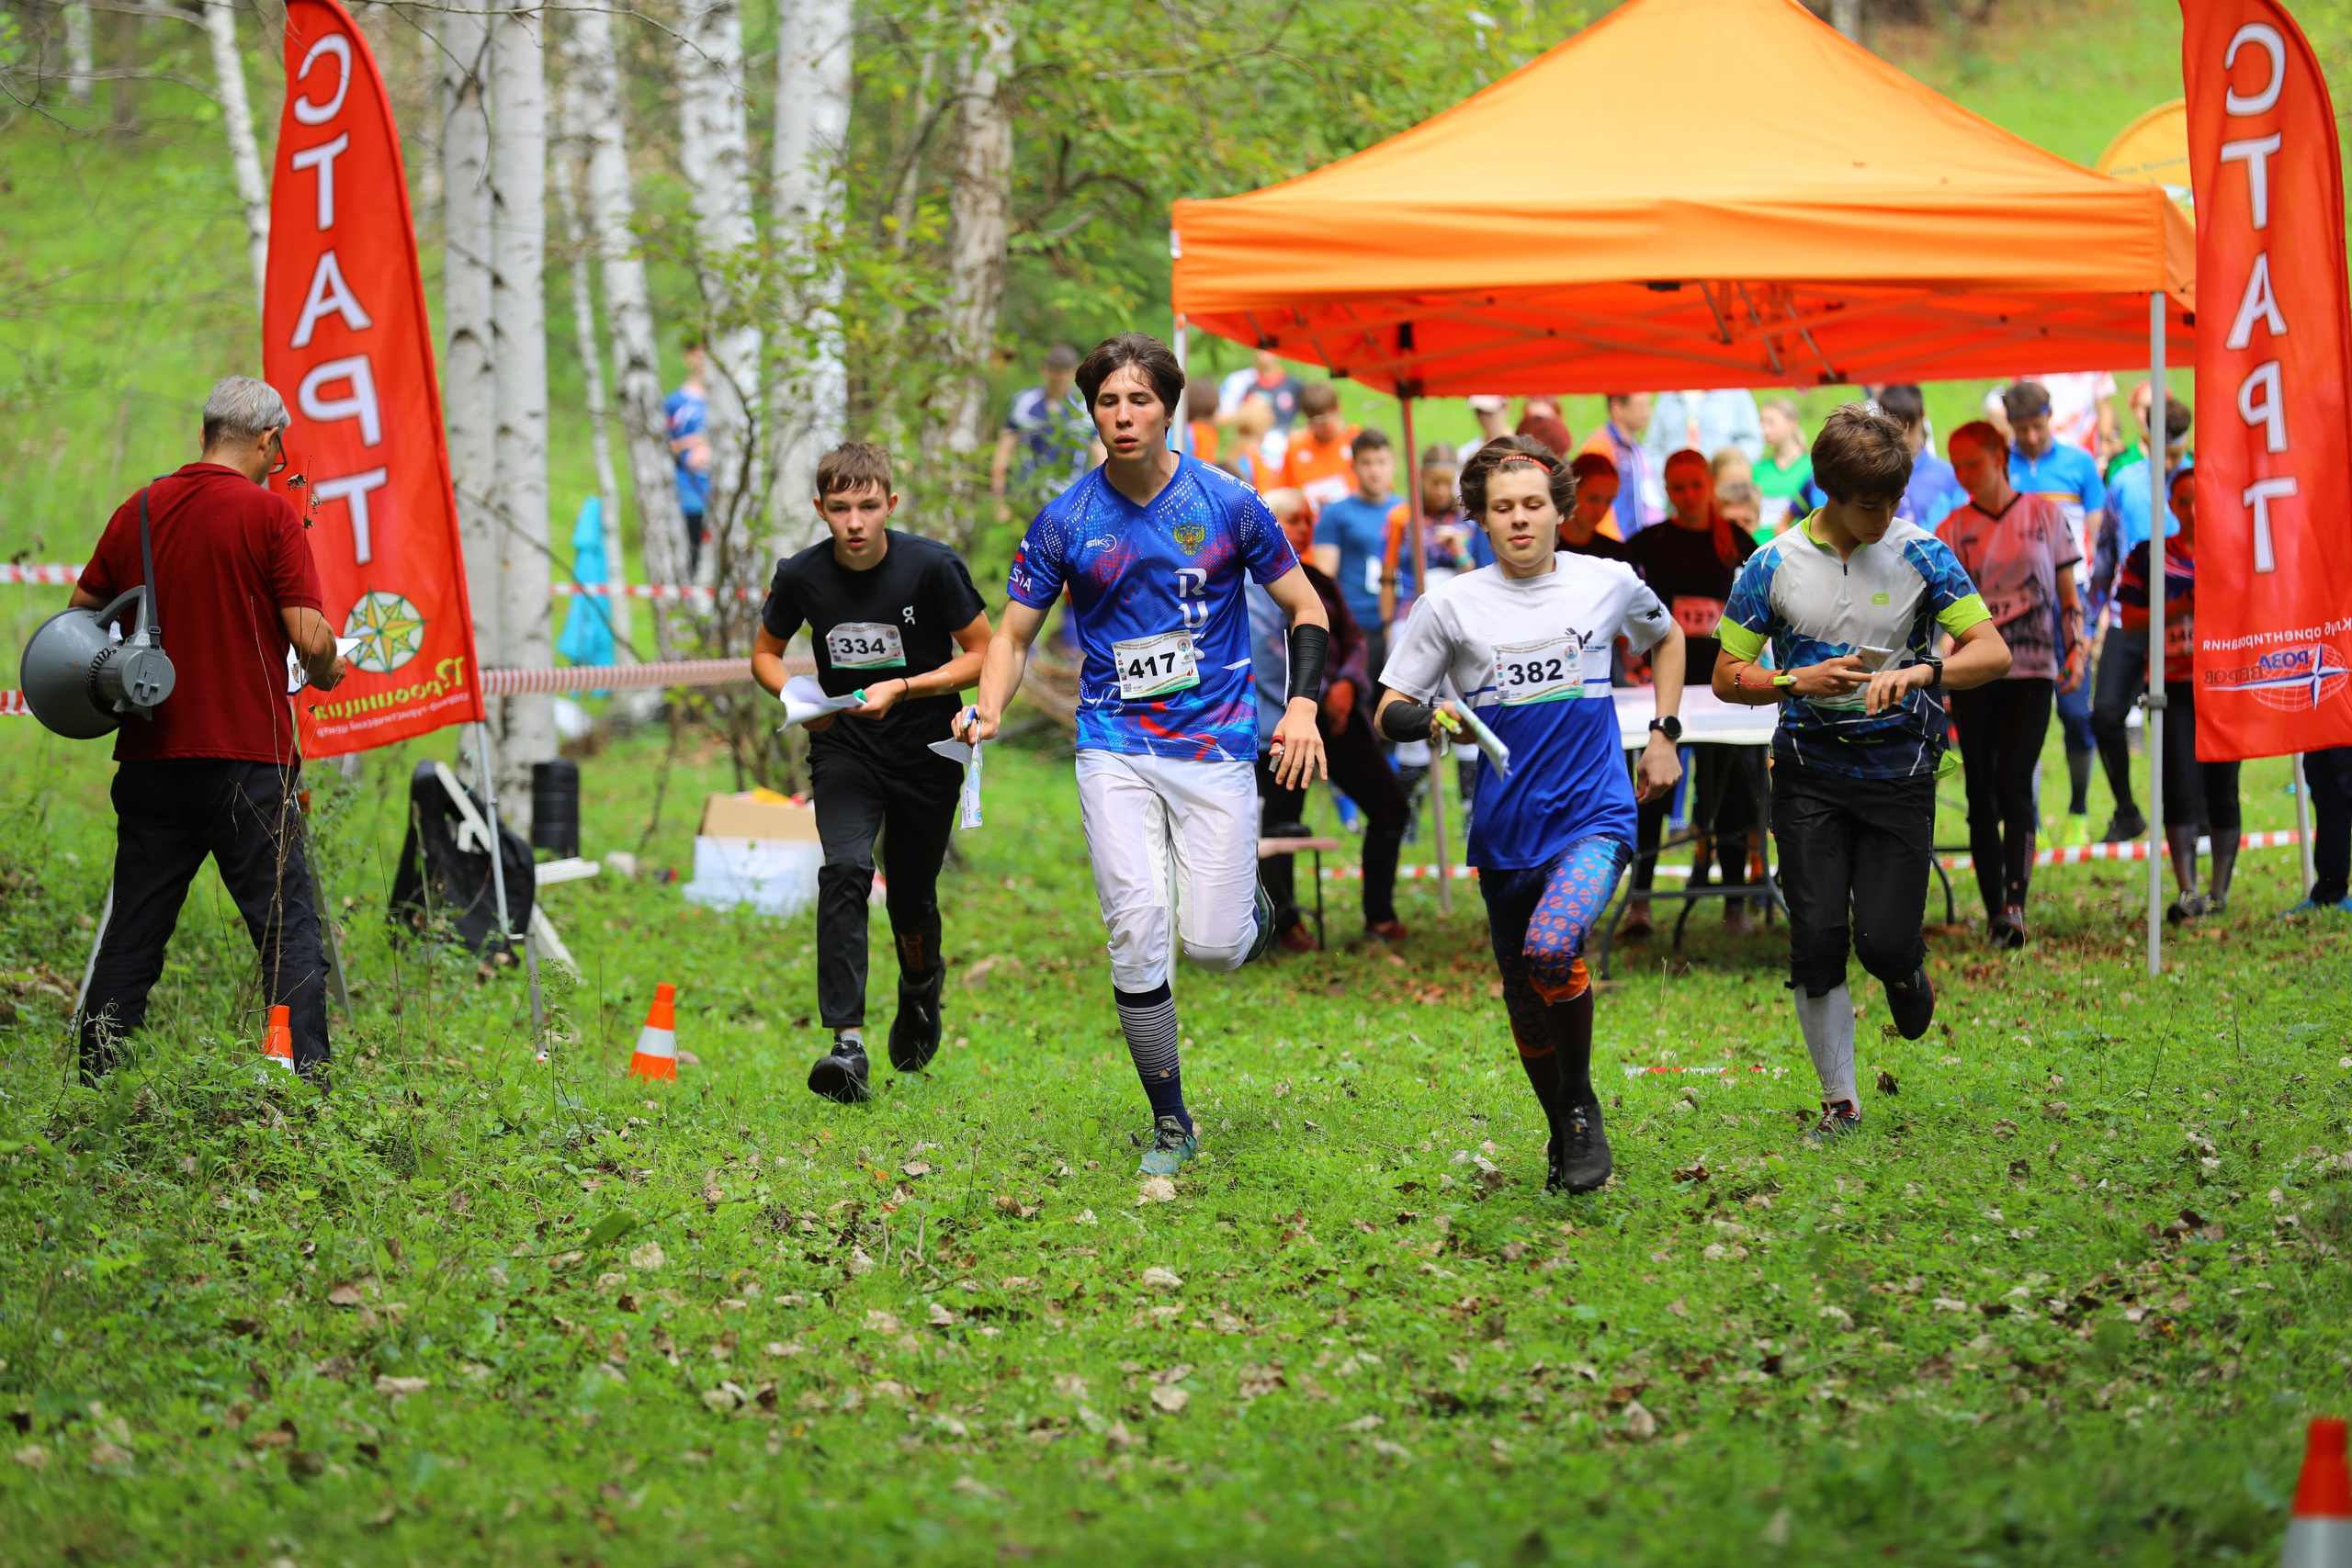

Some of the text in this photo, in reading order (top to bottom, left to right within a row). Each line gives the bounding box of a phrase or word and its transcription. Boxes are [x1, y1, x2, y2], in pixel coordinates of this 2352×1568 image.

[838, 637, 887, 655] 334
[1127, 651, 1176, 679] 417
[1507, 658, 1564, 686] 382
